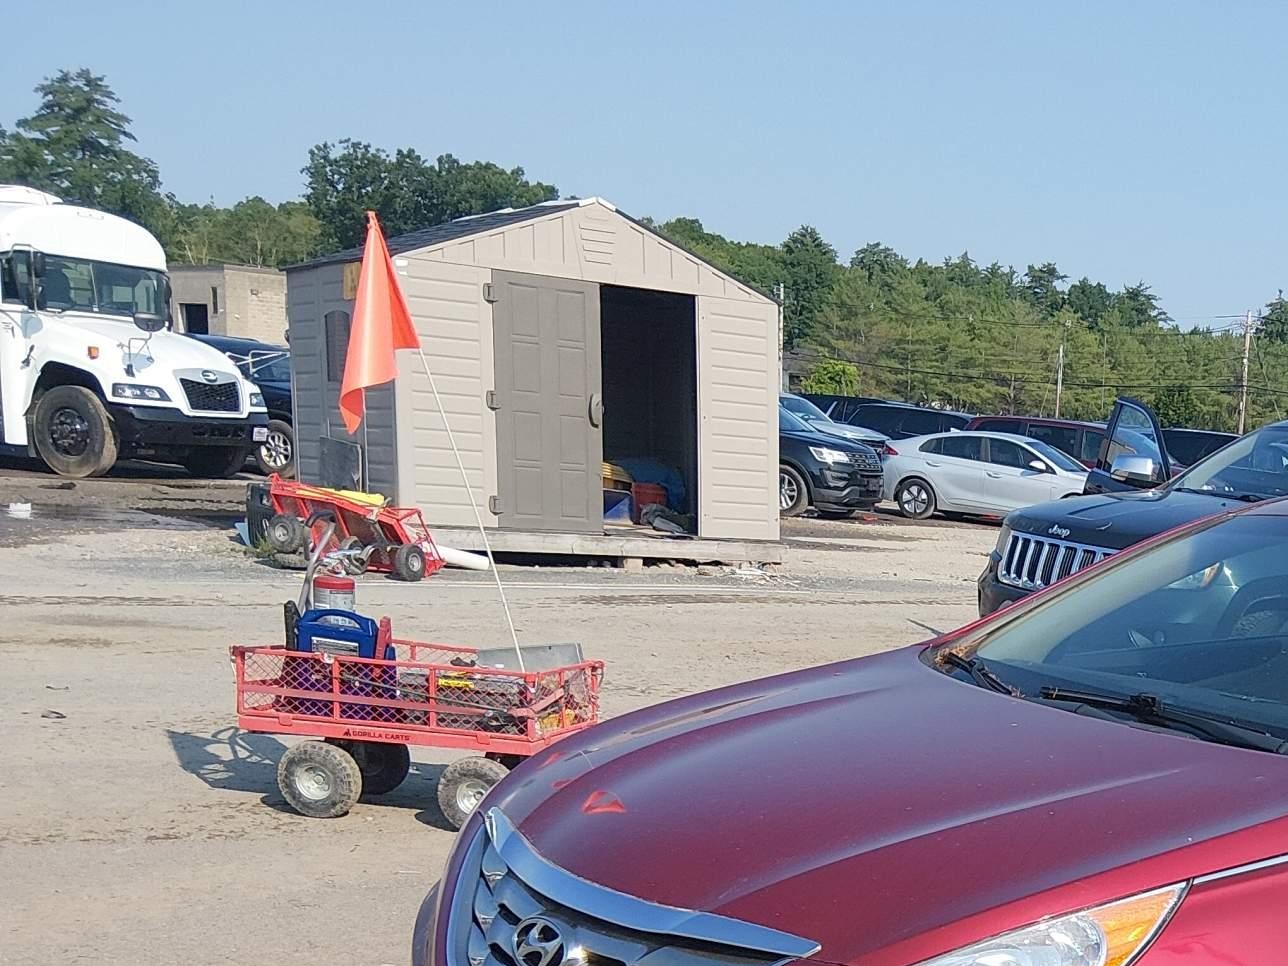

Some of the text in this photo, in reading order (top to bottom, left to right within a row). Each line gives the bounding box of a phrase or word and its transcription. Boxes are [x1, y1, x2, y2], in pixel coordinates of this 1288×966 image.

[1048, 524, 1070, 538] Jeep
[352, 730, 410, 741] GORILLA CARTS
